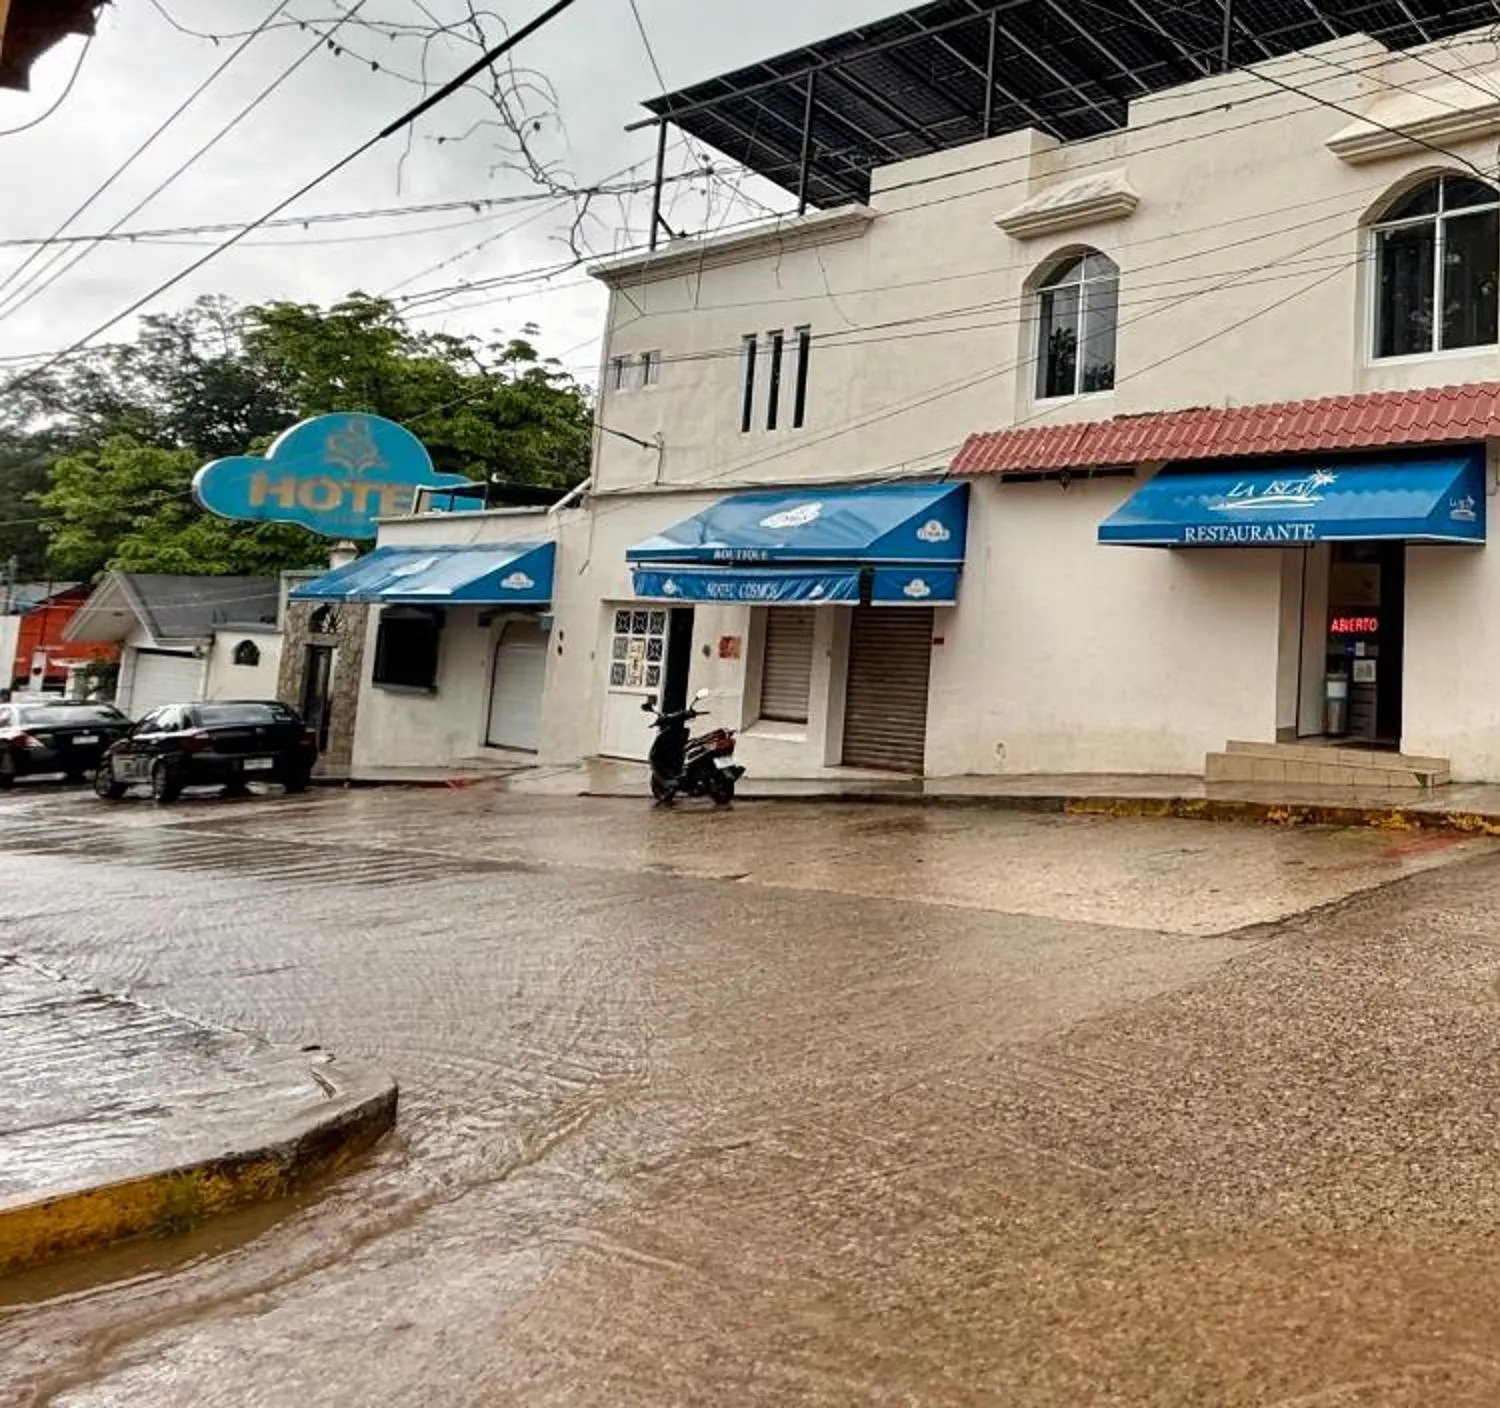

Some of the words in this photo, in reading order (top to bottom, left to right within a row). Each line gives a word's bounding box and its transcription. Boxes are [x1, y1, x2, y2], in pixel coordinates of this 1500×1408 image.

[1226, 481, 1255, 497] LA
[1263, 479, 1309, 496] ISLA
[1184, 523, 1315, 542] RESTAURANTE
[1331, 617, 1378, 633] ABIERTO
